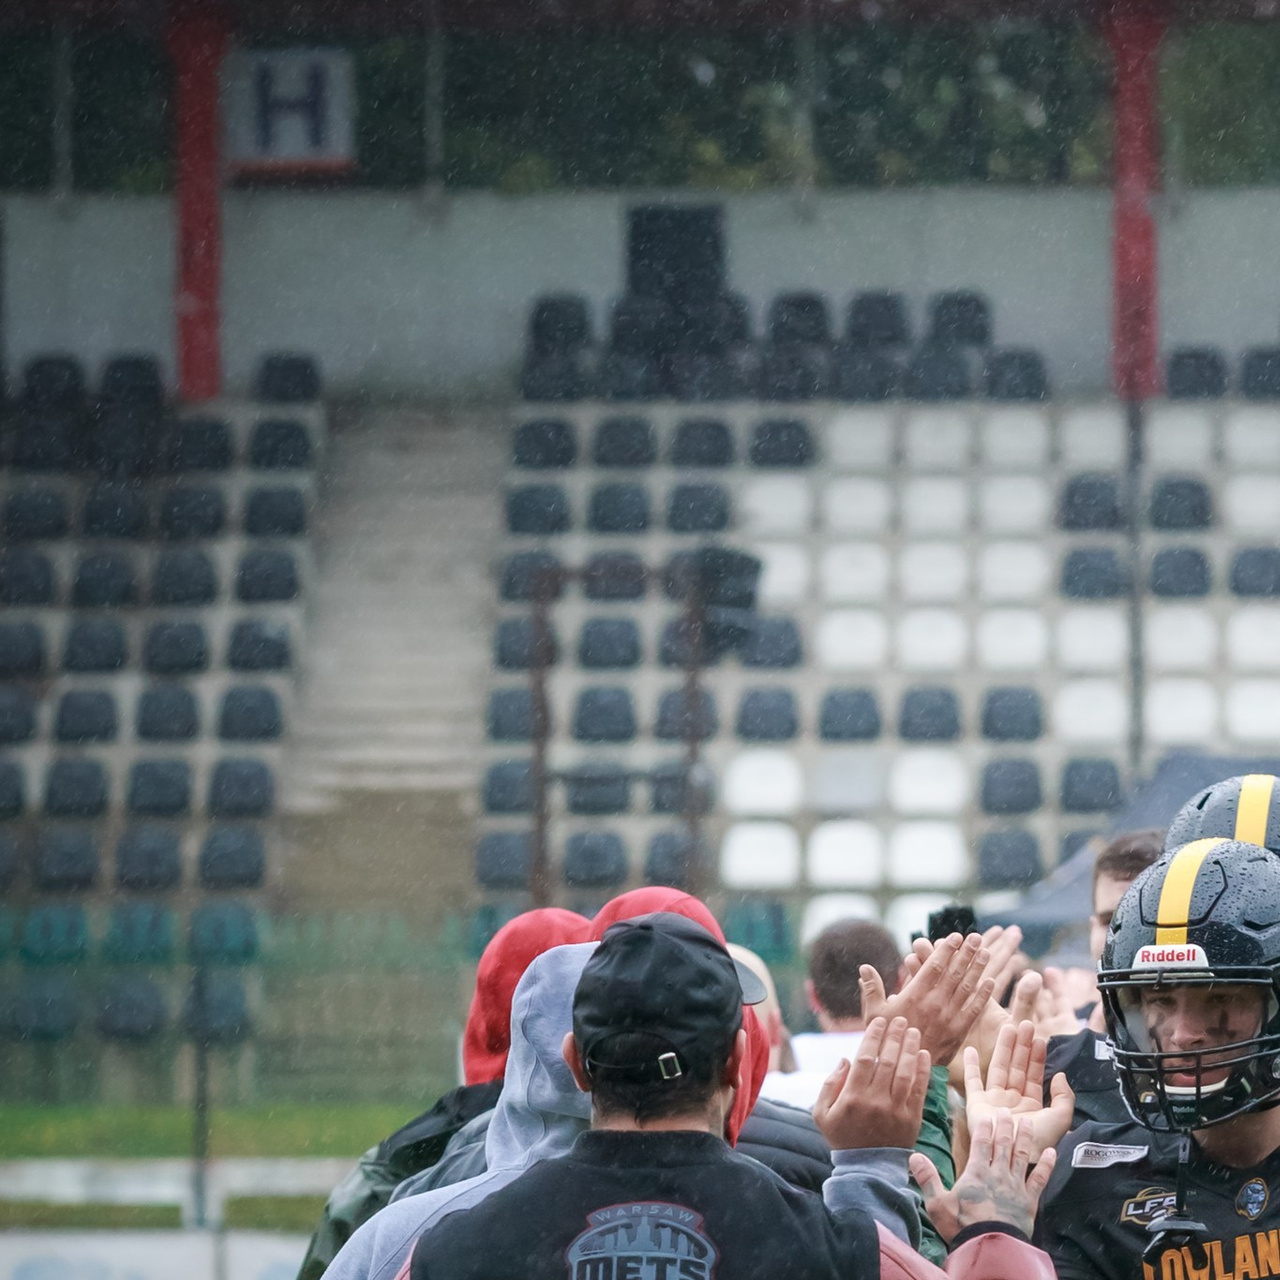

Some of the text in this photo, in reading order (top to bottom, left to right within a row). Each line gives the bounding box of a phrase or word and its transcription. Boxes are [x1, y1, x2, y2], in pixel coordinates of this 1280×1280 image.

[252, 60, 327, 149] H
[1141, 949, 1196, 962] Riddell
[595, 1205, 695, 1223] WARSAW
